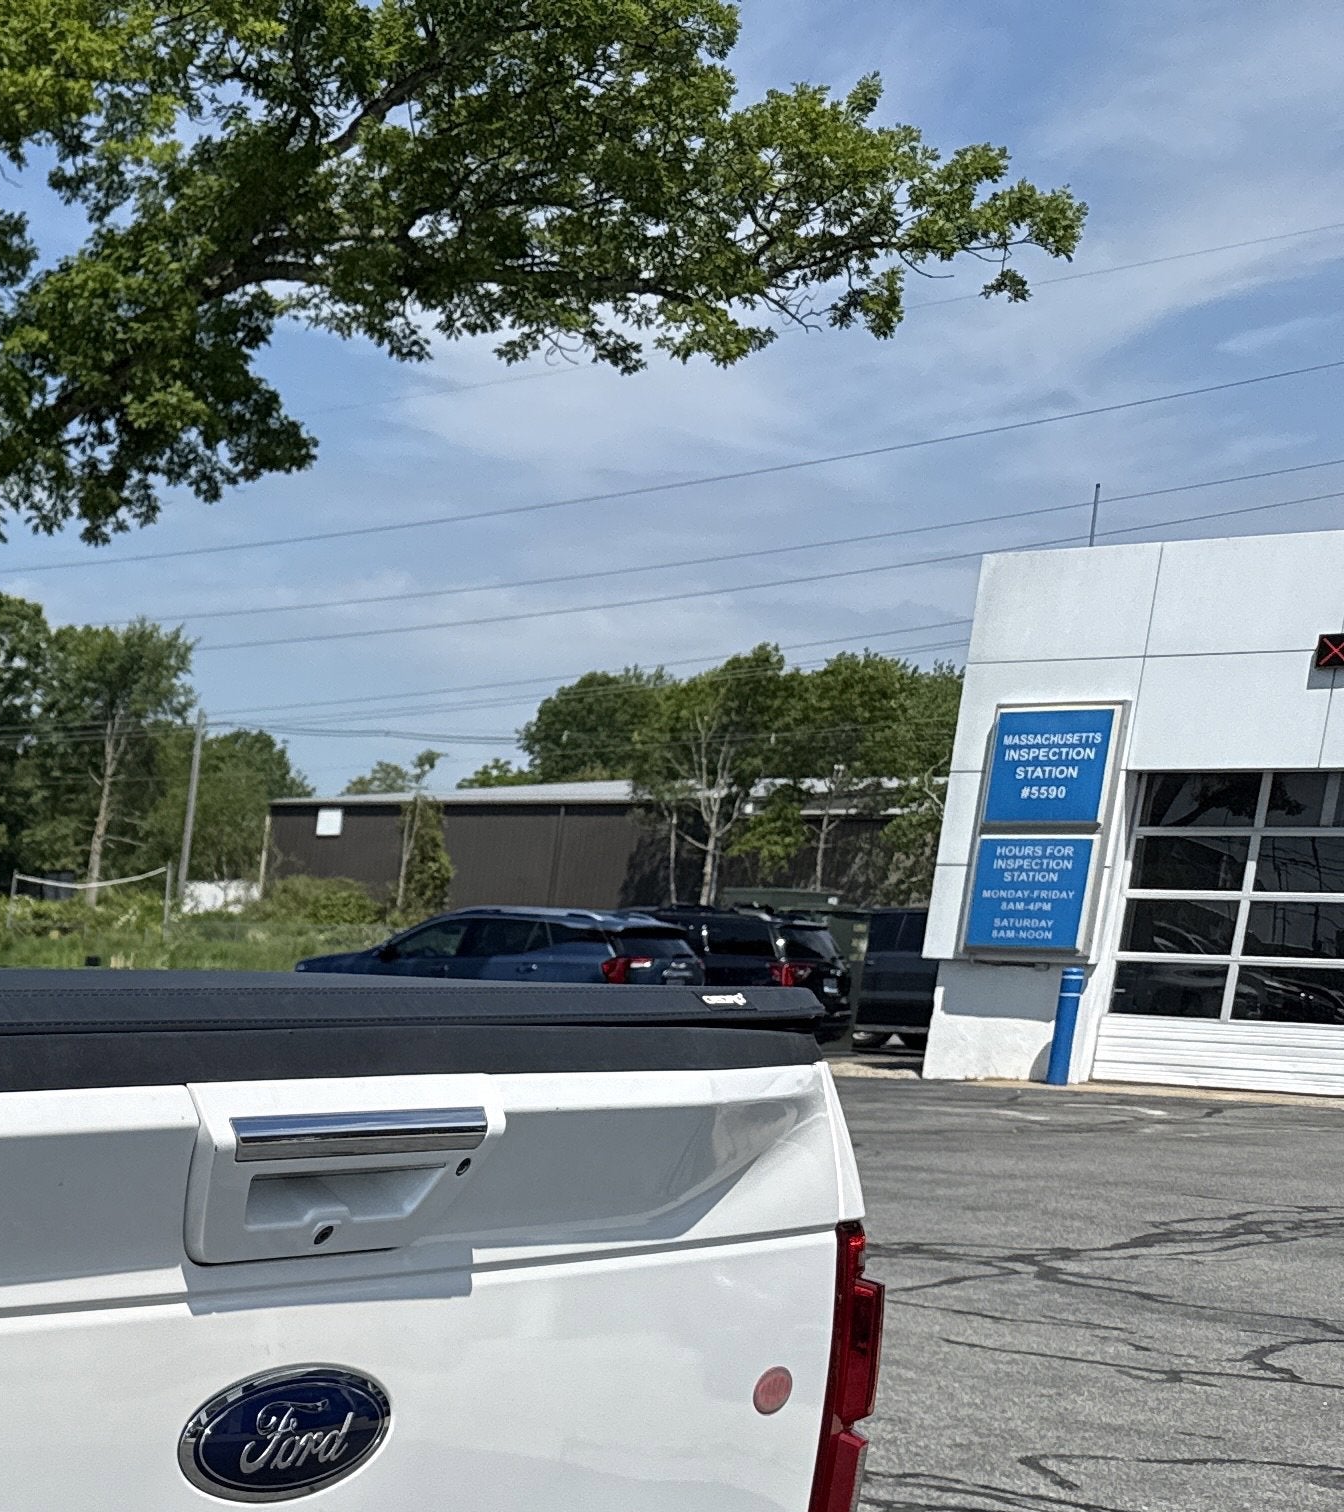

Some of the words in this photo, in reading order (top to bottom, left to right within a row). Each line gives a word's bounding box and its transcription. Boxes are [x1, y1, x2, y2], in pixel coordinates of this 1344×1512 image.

[1003, 732, 1102, 746] MASSACHUSETTS
[1004, 747, 1096, 761] INSPECTION
[1015, 766, 1079, 780] STATION
[1020, 786, 1067, 799] #5590
[996, 846, 1043, 857] HOURS
[1046, 846, 1075, 857] FOR
[993, 858, 1073, 870] INSPECTION
[1003, 872, 1059, 882] STATION
[982, 890, 1075, 899] MONDAY-FRIDAY
[993, 918, 1054, 928] SATURDAY
[240, 1398, 355, 1474] Ford
